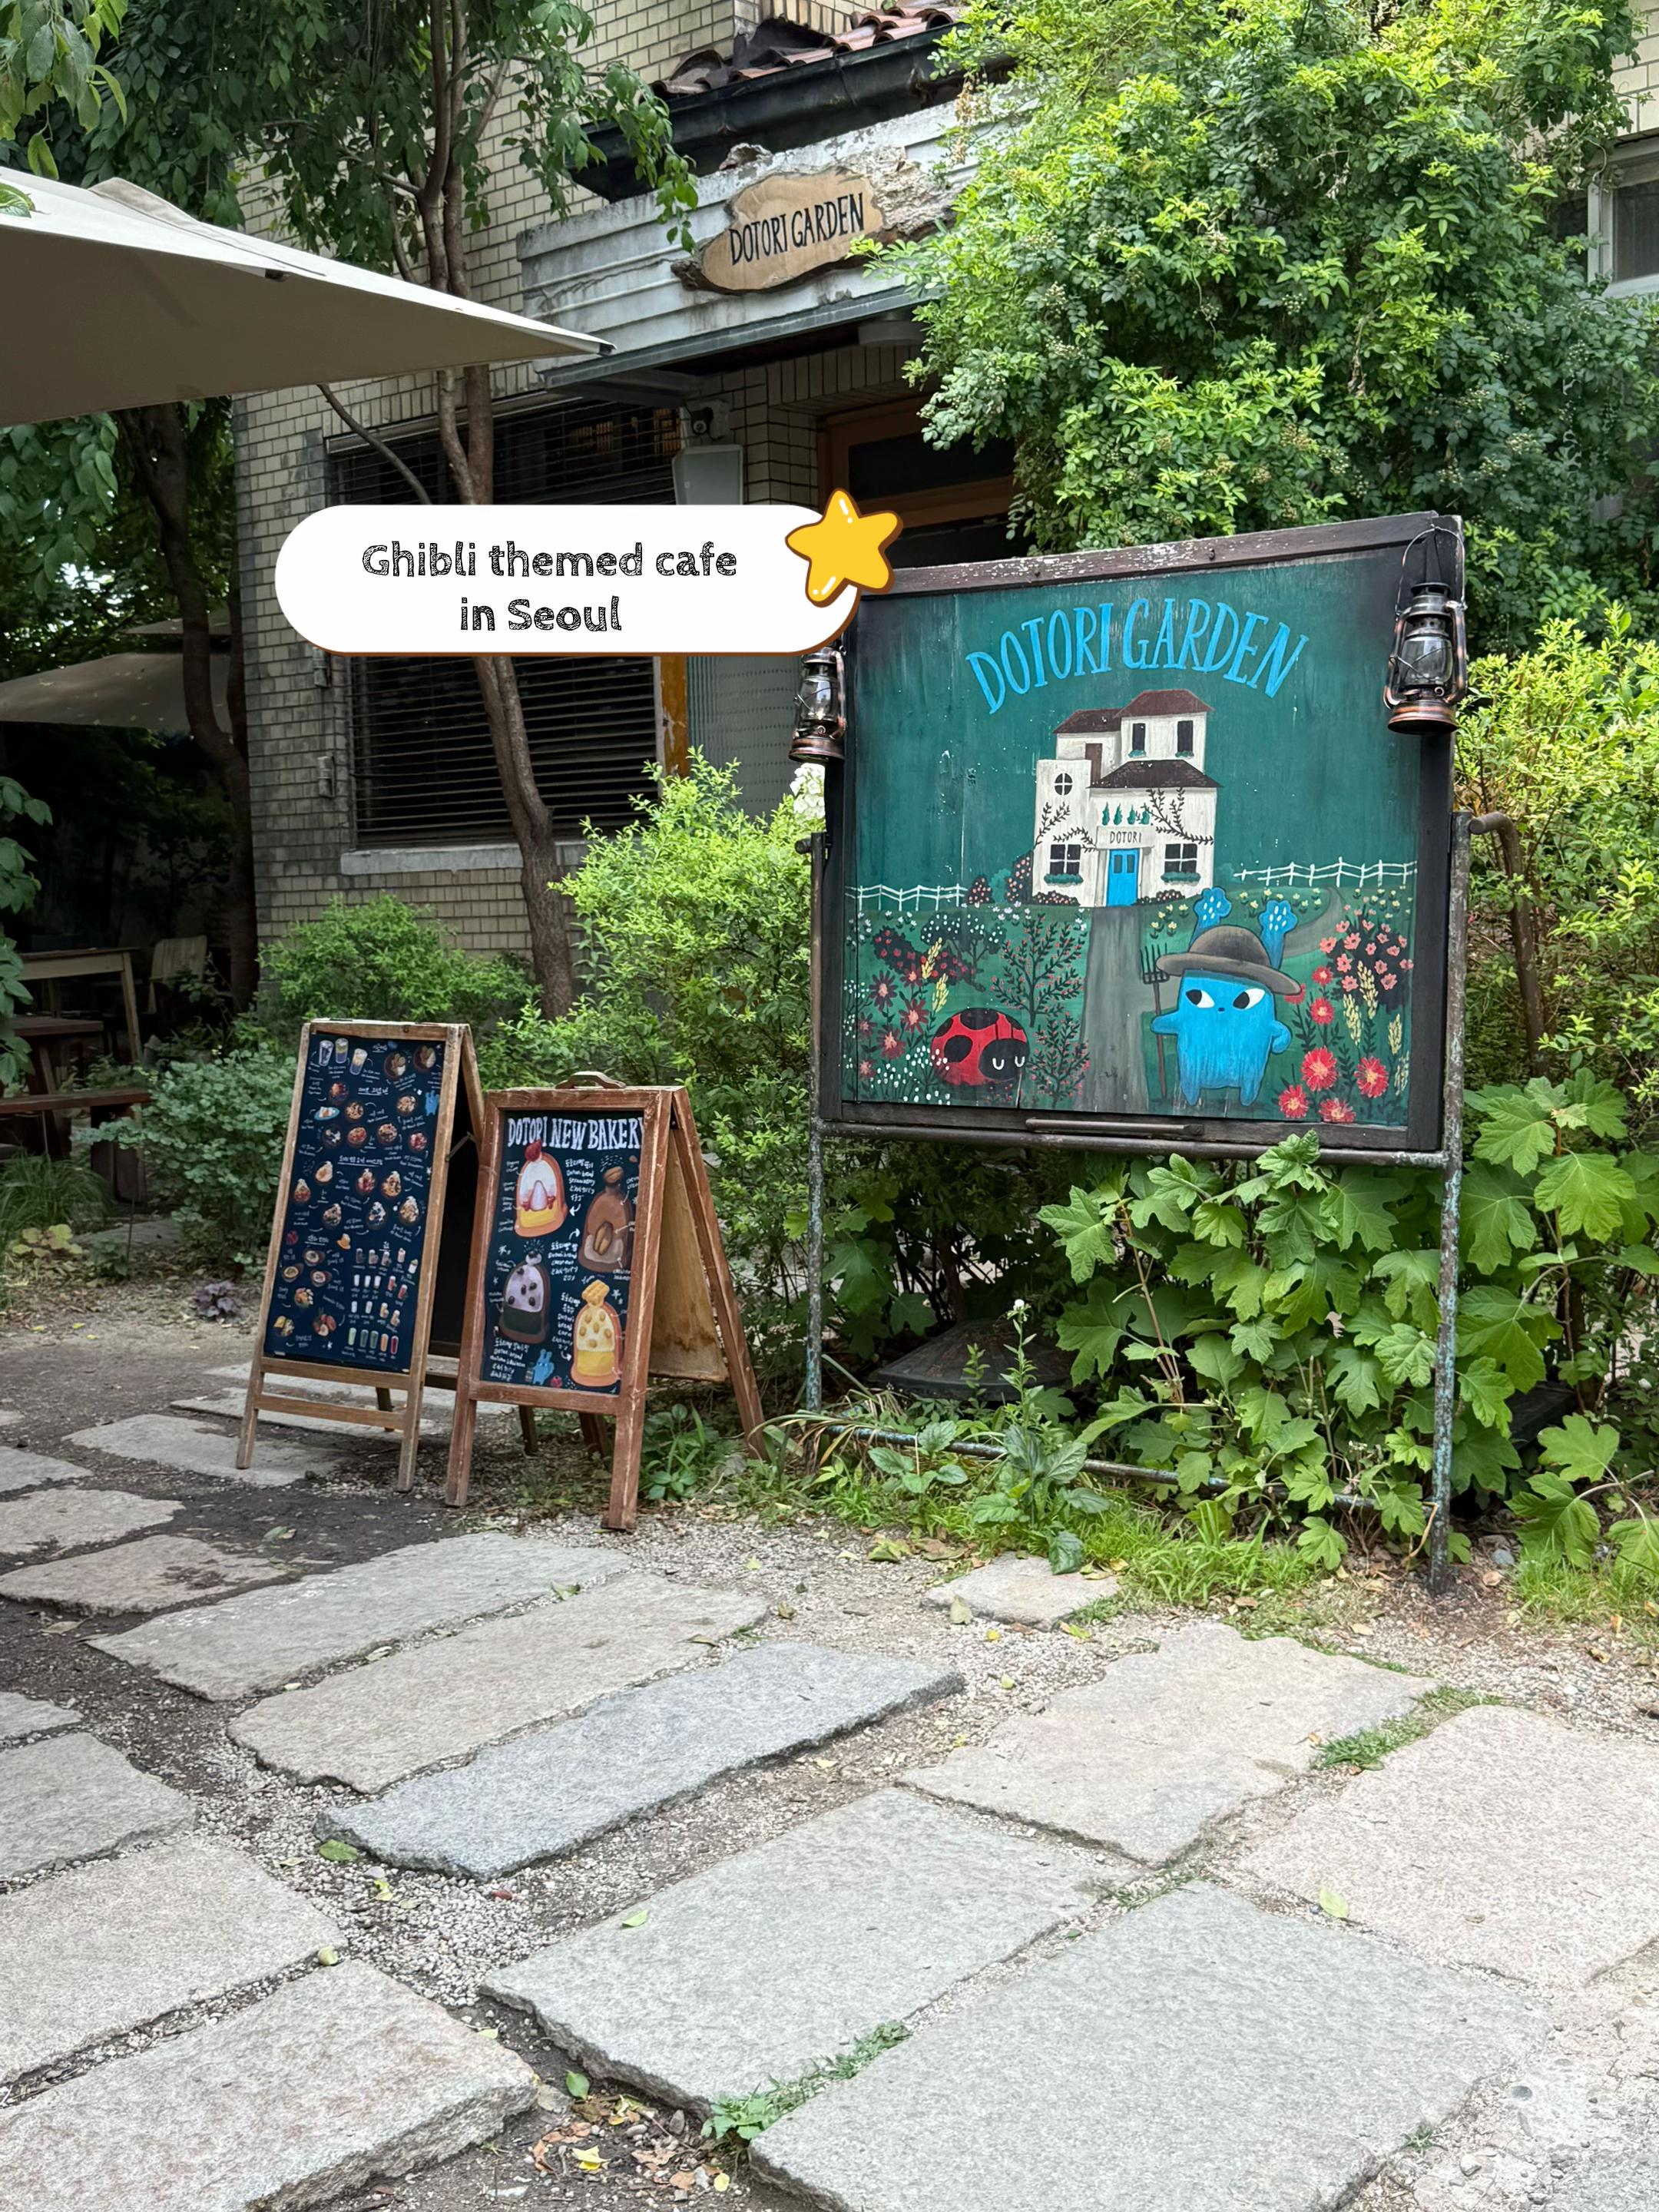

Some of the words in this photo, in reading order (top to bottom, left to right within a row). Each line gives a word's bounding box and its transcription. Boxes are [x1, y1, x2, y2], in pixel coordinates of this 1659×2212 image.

[729, 214, 788, 266] DOTORI
[791, 192, 865, 248] GARDEN
[965, 602, 1114, 714] DOTORI
[1123, 598, 1310, 699] GARDEN
[1110, 830, 1142, 843] DOTORI
[507, 1116, 548, 1147] DOTORI
[548, 1118, 588, 1151] NEW
[587, 1117, 644, 1151] BAKERY
